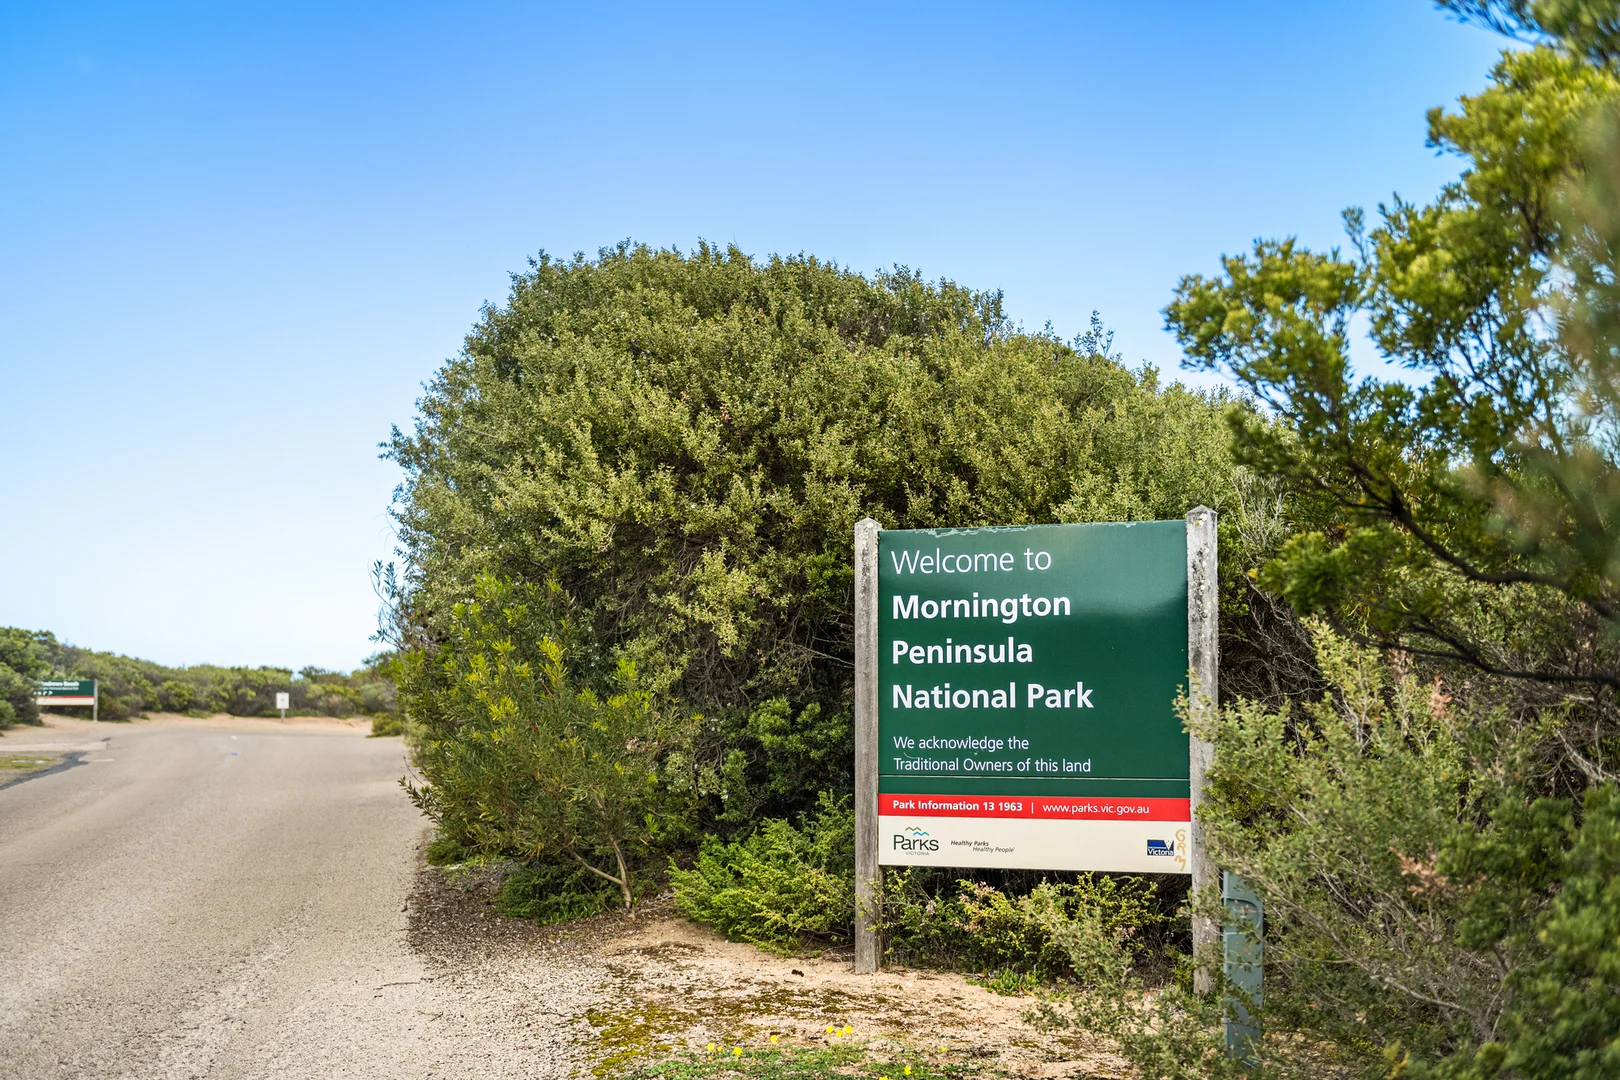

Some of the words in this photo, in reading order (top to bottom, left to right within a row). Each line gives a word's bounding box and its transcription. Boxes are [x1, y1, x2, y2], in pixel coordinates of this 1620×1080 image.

[891, 548, 1014, 575] Welcome
[1024, 548, 1052, 571] to
[892, 592, 1071, 624] Mornington
[892, 637, 1033, 664] Peninsula
[892, 682, 1016, 709] National
[1027, 682, 1094, 709] Park
[893, 736, 915, 749] We
[918, 736, 1004, 752] acknowledge
[1007, 736, 1029, 749] the
[893, 757, 959, 771] Traditional
[963, 758, 1013, 771] Owners
[1016, 757, 1032, 772] of
[1034, 758, 1059, 772] this
[1062, 758, 1091, 772] land
[892, 800, 916, 809] Park
[918, 801, 980, 811] Information
[982, 801, 995, 811] 13
[998, 802, 1023, 812] 1963
[1042, 804, 1150, 815] www.parks.vic.gov.au
[893, 834, 939, 851] Parks
[1147, 848, 1174, 856] Victoria
